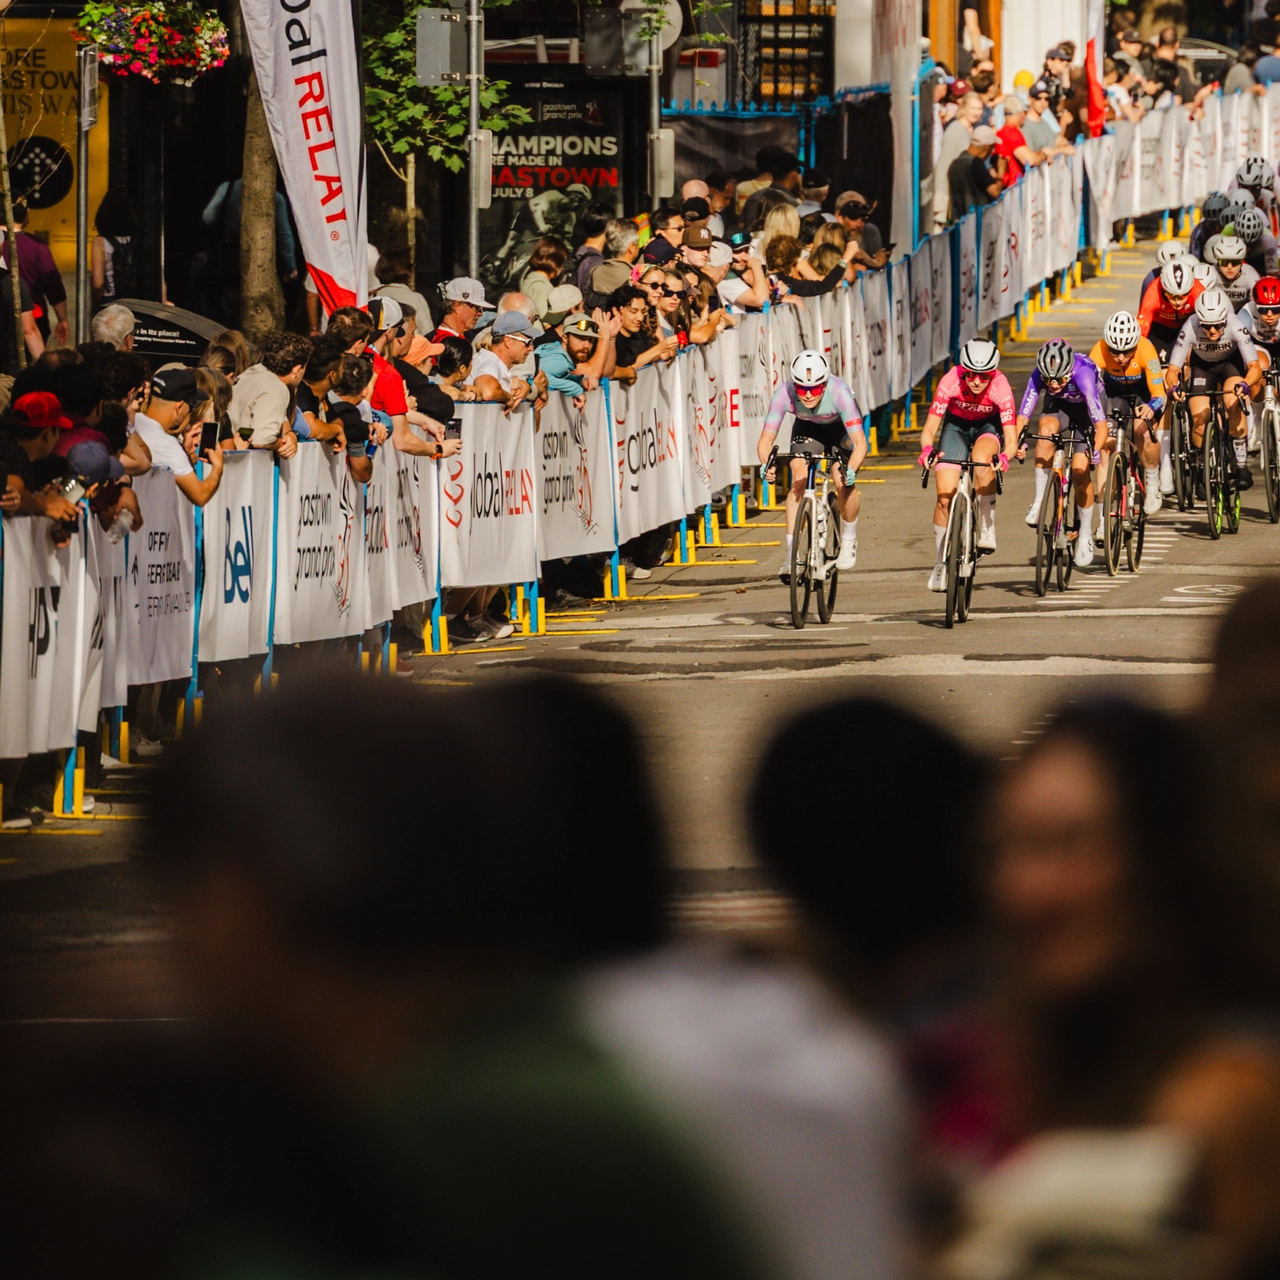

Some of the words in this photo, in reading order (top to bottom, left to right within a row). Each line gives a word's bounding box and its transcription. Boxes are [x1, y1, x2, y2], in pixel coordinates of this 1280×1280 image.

[542, 102, 577, 113] gastown
[492, 135, 618, 156] HAMPIONS
[492, 156, 505, 166] RE
[508, 156, 546, 166] MADE
[548, 156, 563, 166] IN
[492, 187, 525, 198] JULY
[525, 187, 534, 198] 8
[224, 505, 255, 604] Bell
